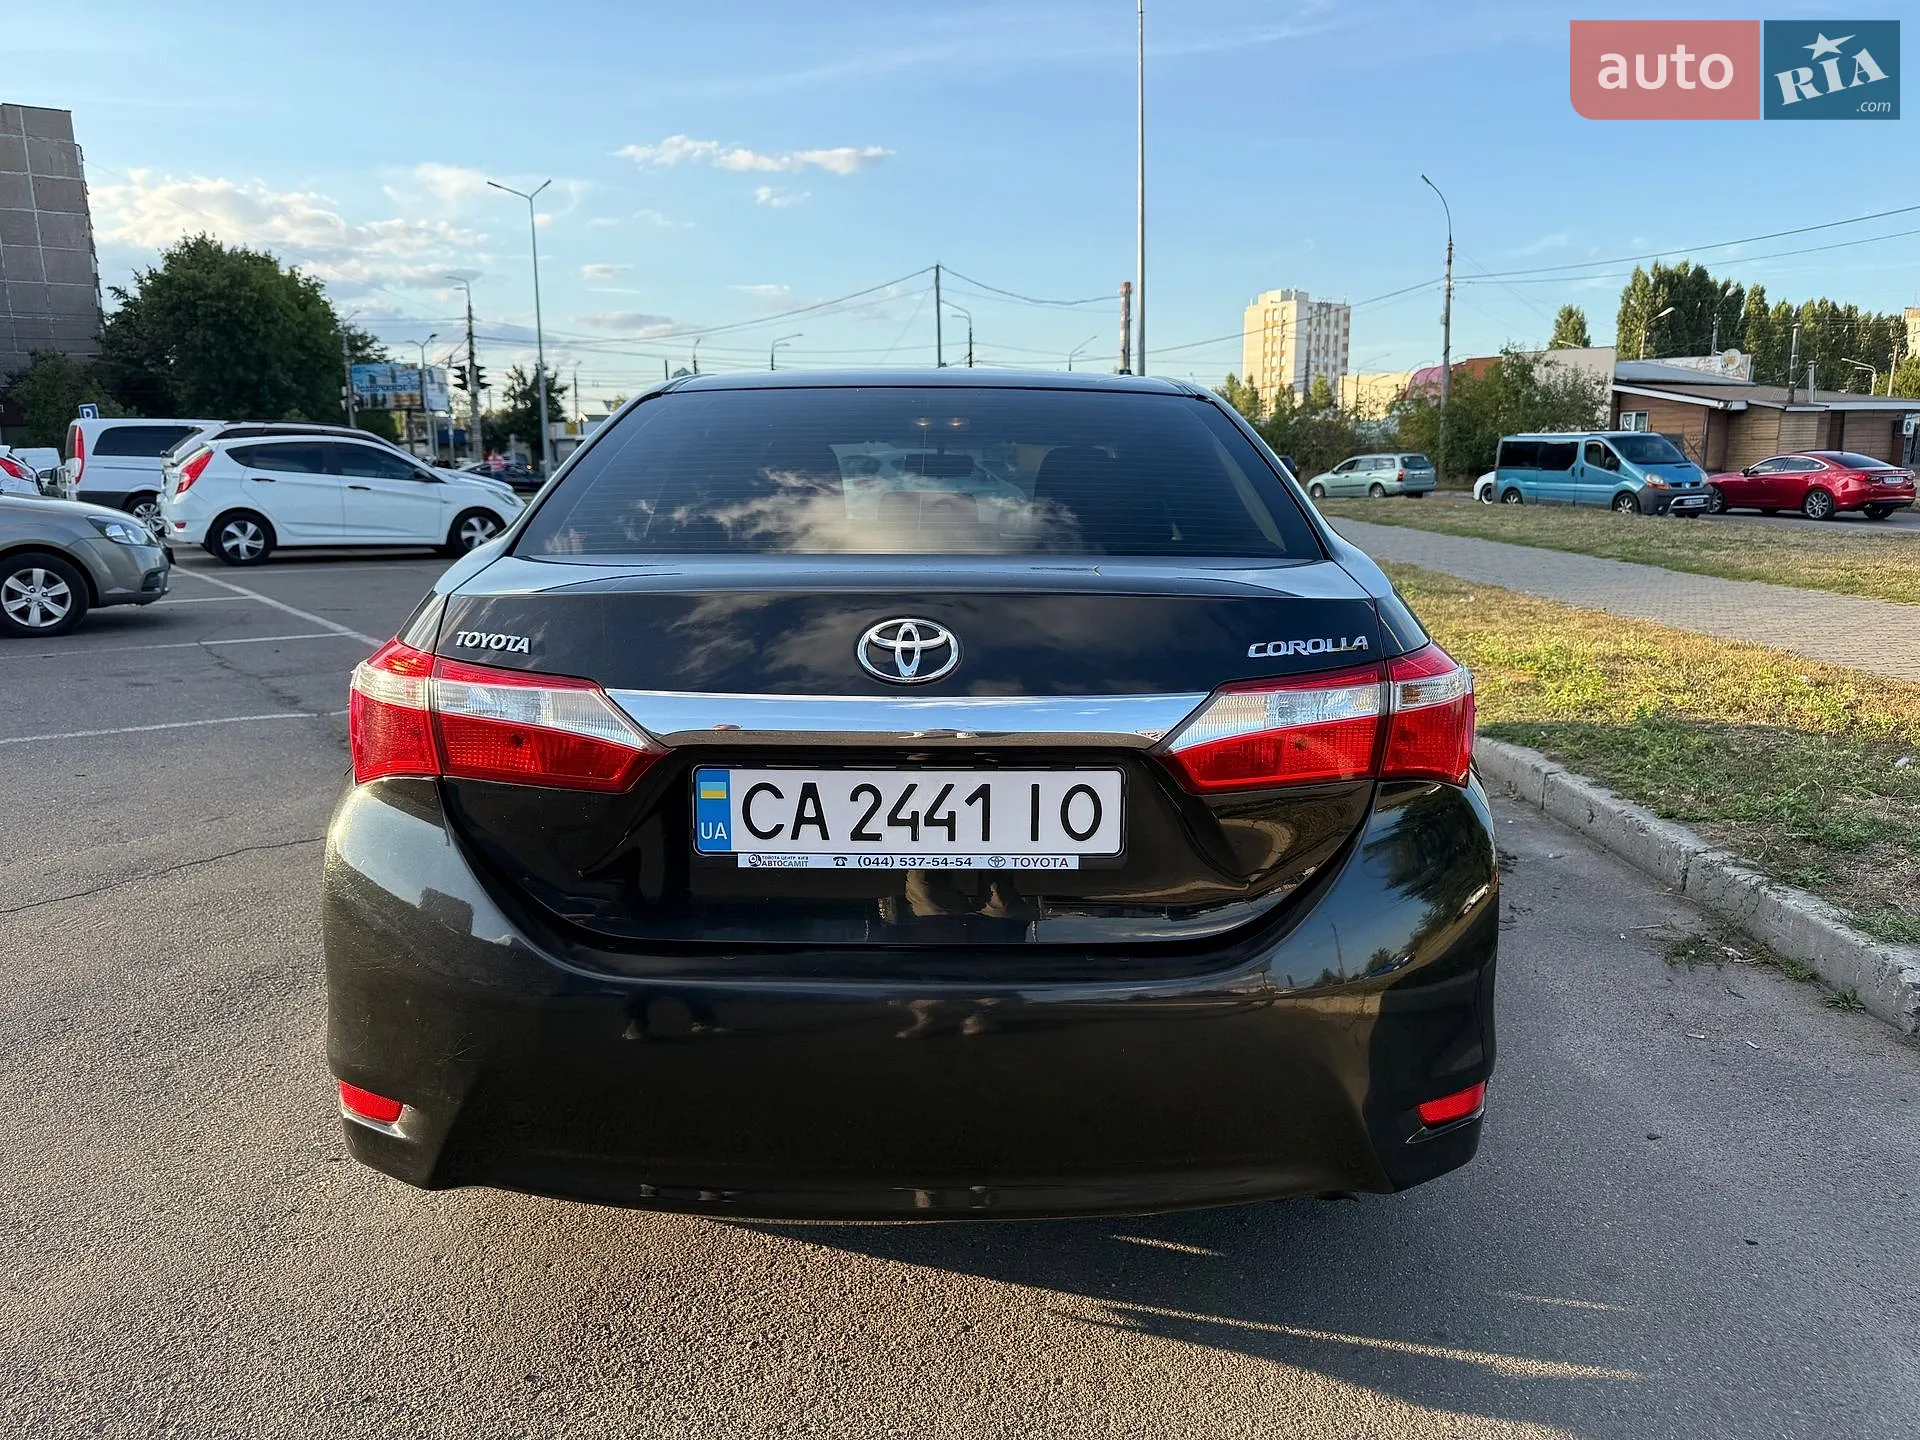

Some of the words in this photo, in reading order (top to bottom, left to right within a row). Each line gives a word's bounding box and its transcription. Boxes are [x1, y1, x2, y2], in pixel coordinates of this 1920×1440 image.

[455, 631, 530, 654] TOYOTA
[1247, 635, 1369, 658] COROLLA
[741, 782, 830, 841] CA
[849, 783, 991, 841] 2441
[1030, 783, 1102, 841] IO
[701, 822, 728, 840] UA
[857, 856, 895, 868] (044)
[899, 856, 973, 867] 537-54-54
[1011, 857, 1069, 868] TOYOTA
